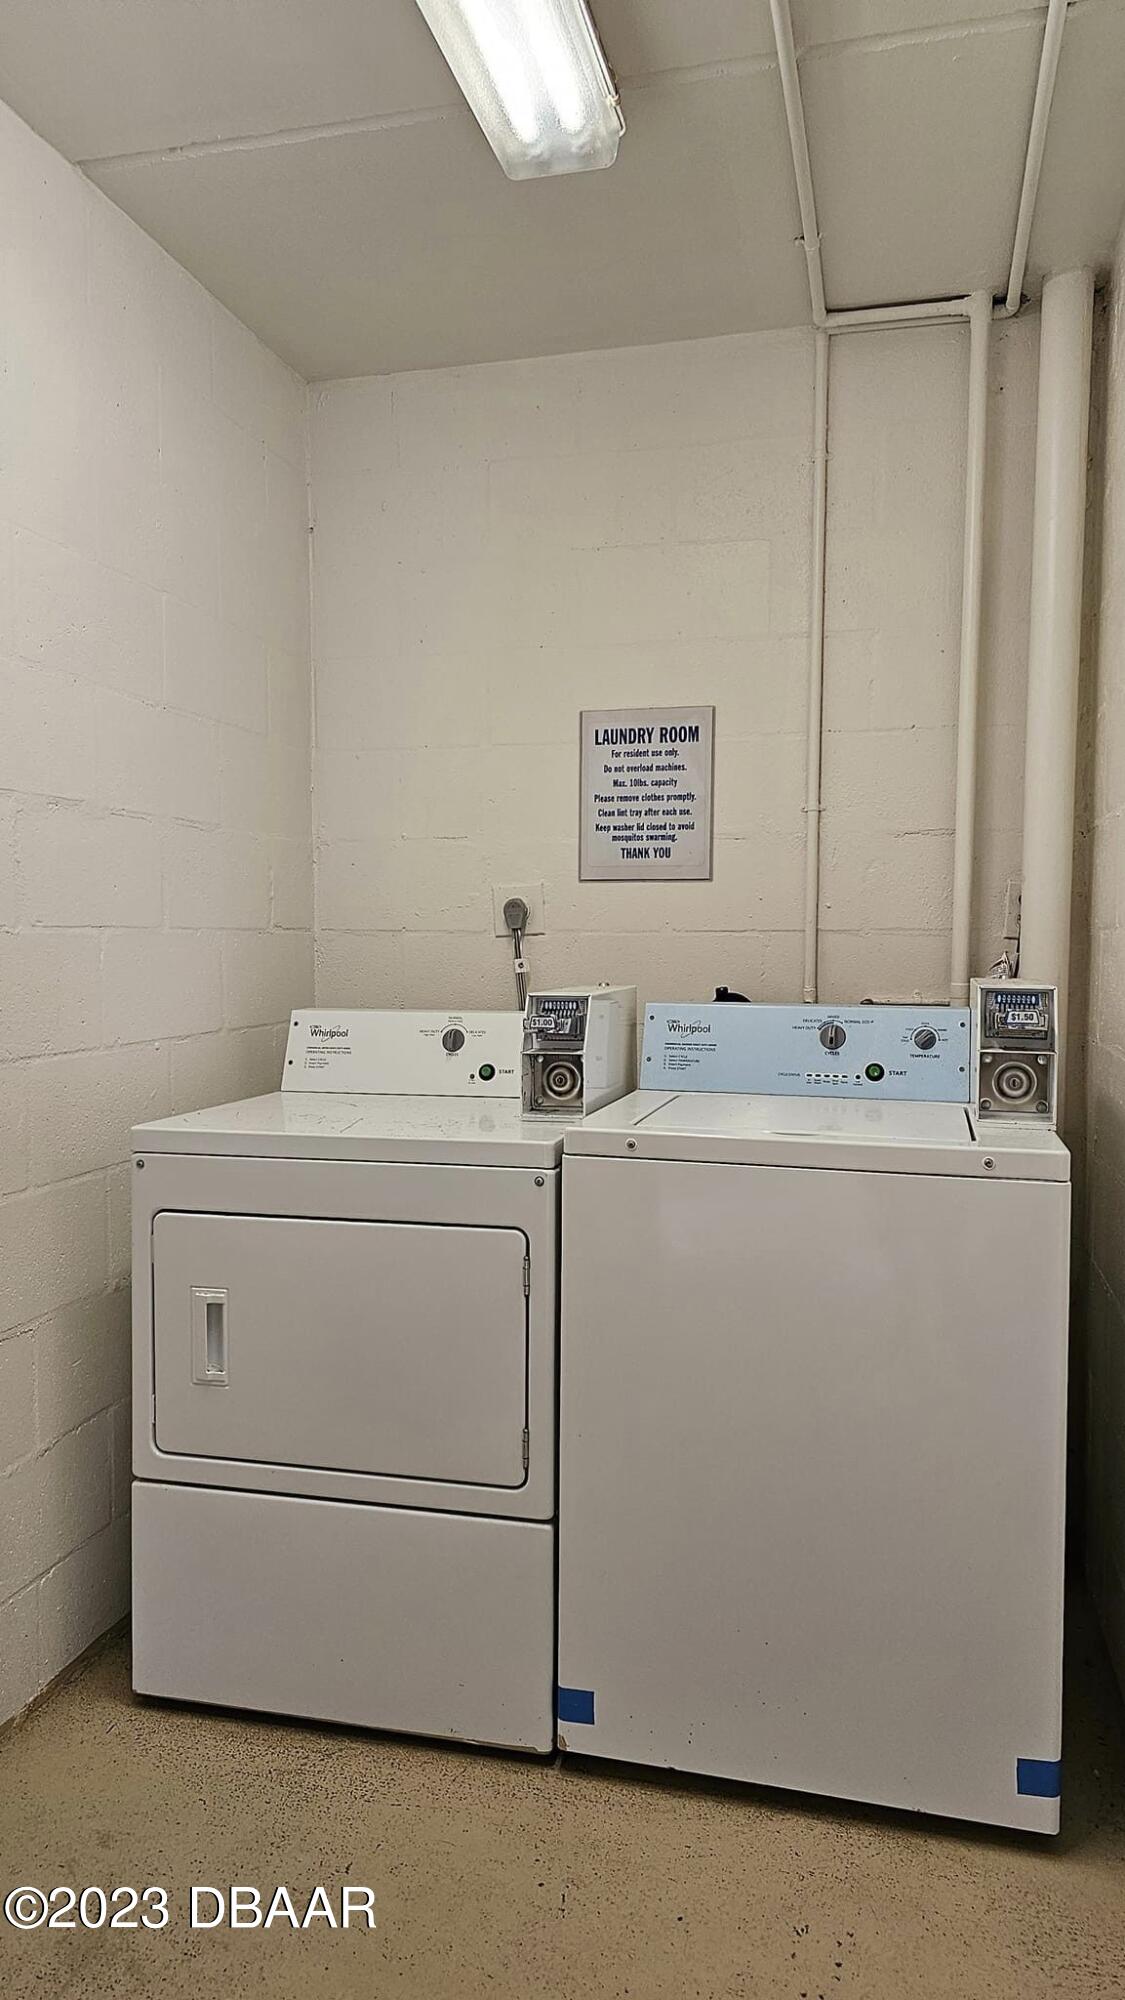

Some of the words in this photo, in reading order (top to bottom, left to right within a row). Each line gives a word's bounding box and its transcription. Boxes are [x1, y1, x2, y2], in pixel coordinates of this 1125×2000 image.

[595, 727, 654, 745] LAUNDRY
[660, 726, 699, 743] ROOM
[611, 750, 621, 758] For
[623, 749, 649, 758] resident
[665, 748, 679, 758] only.
[604, 765, 612, 773] Do
[626, 764, 653, 772] overload
[655, 762, 687, 771] machines.
[613, 779, 627, 787] Max.
[630, 779, 649, 787] 10lbs.
[651, 778, 678, 788] capacity
[594, 794, 614, 802] Please
[642, 793, 664, 801] clothes
[666, 792, 696, 802] promptly.
[598, 809, 615, 817] Clean
[630, 809, 642, 818] tray
[644, 808, 660, 816] after
[662, 807, 677, 815] each
[595, 823, 611, 832] Keep
[636, 822, 644, 830] lid
[646, 822, 667, 830] closed
[669, 822, 675, 830] to
[678, 822, 695, 830] avoid
[612, 834, 644, 843] mosquitos
[646, 832, 677, 842] swarming.
[621, 847, 650, 859] THANK
[653, 847, 671, 858] YOU
[532, 1018, 553, 1026] $1.00
[1011, 1013, 1034, 1021] $1.50
[310, 1029, 349, 1039] Whirlpool
[668, 1024, 711, 1034] Whirlpool
